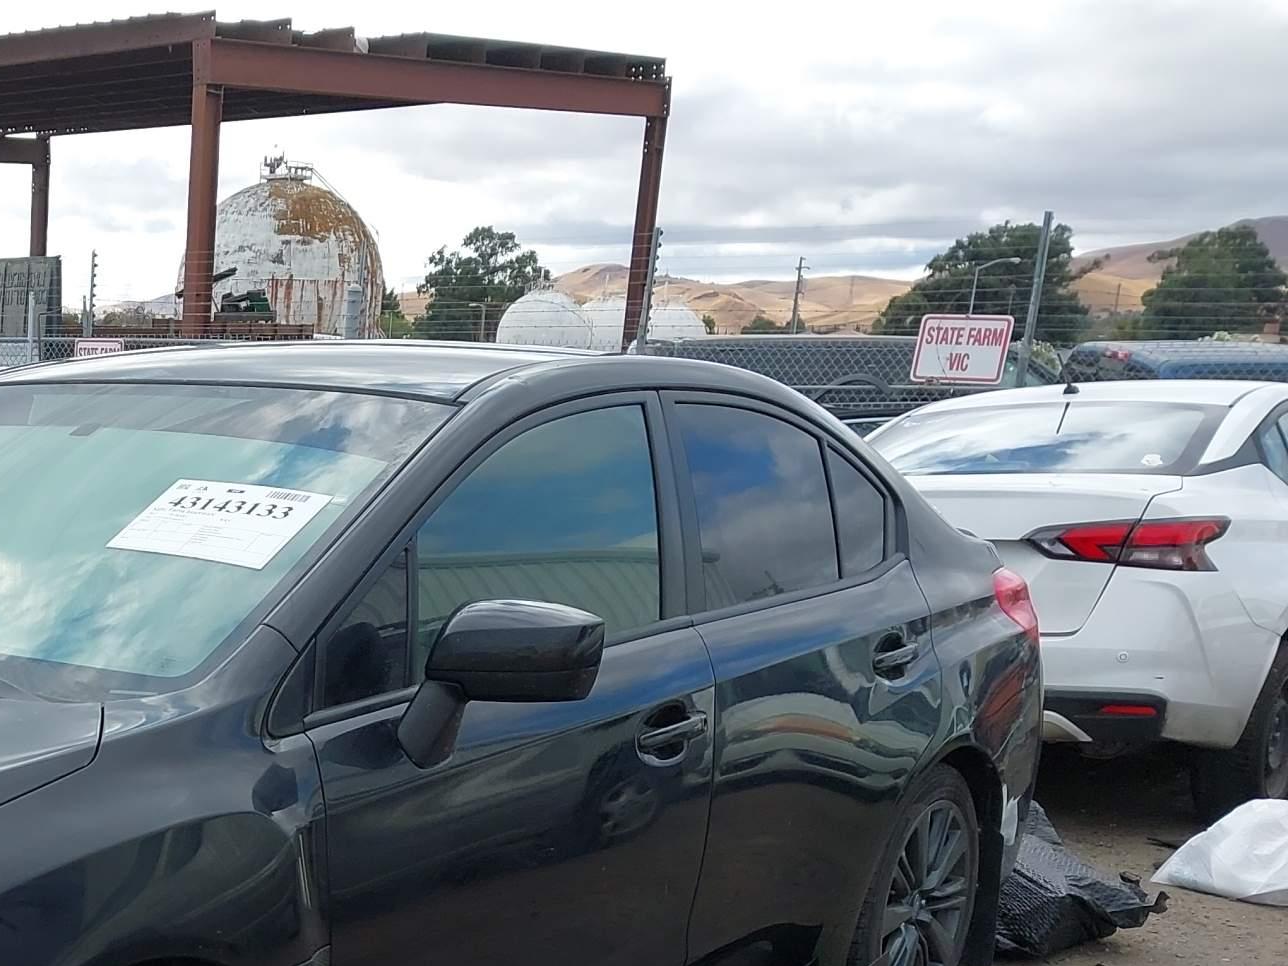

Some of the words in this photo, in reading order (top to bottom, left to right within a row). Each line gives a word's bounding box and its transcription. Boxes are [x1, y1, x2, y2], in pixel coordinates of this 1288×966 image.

[925, 326, 965, 346] STATE
[966, 327, 1004, 347] FARM
[948, 352, 970, 372] VIC
[168, 495, 294, 520] 43143133
